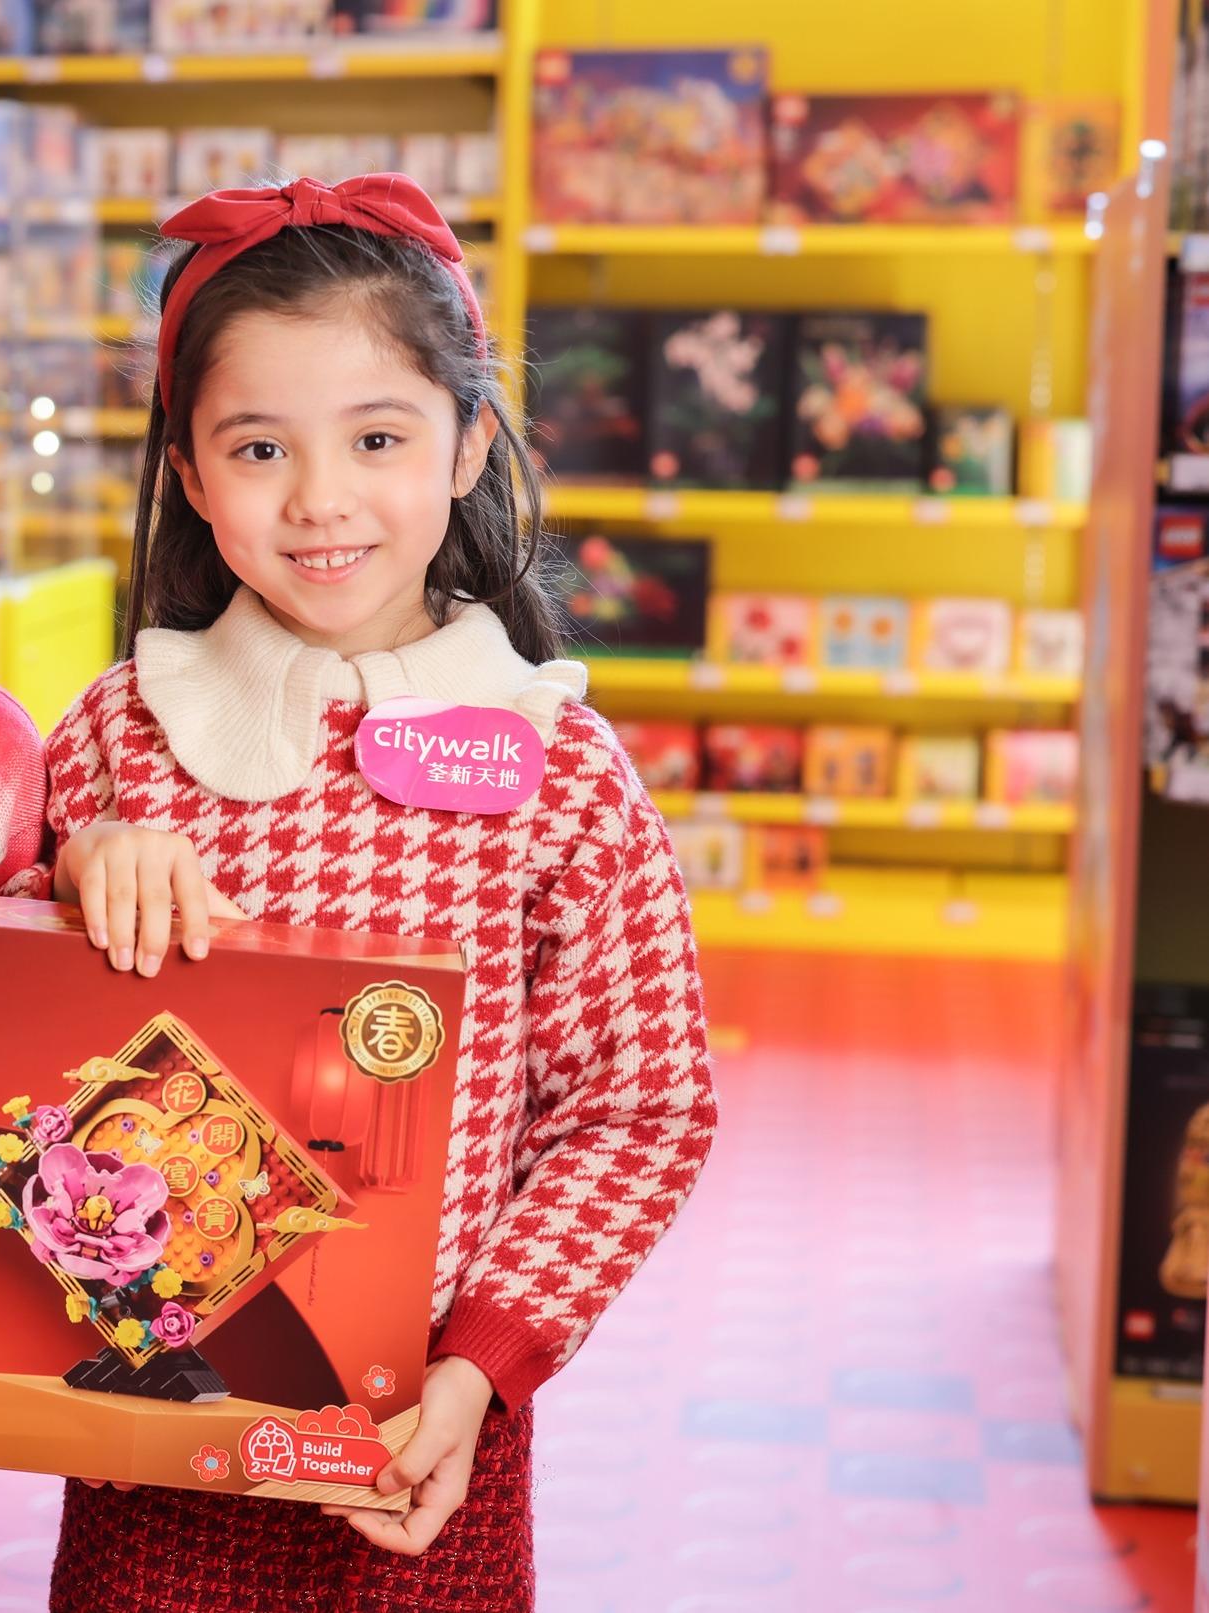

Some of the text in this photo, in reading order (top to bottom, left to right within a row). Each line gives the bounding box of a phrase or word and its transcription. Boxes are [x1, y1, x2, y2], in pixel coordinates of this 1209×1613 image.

[374, 720, 523, 764] citywalk
[427, 761, 520, 791] 荃新天地
[367, 1005, 415, 1060] 春
[169, 1078, 200, 1108] 花
[207, 1123, 238, 1148] 開
[164, 1160, 192, 1189] 富
[199, 1200, 233, 1232] 貴
[303, 1441, 342, 1457] Build
[301, 1457, 373, 1476] Together
